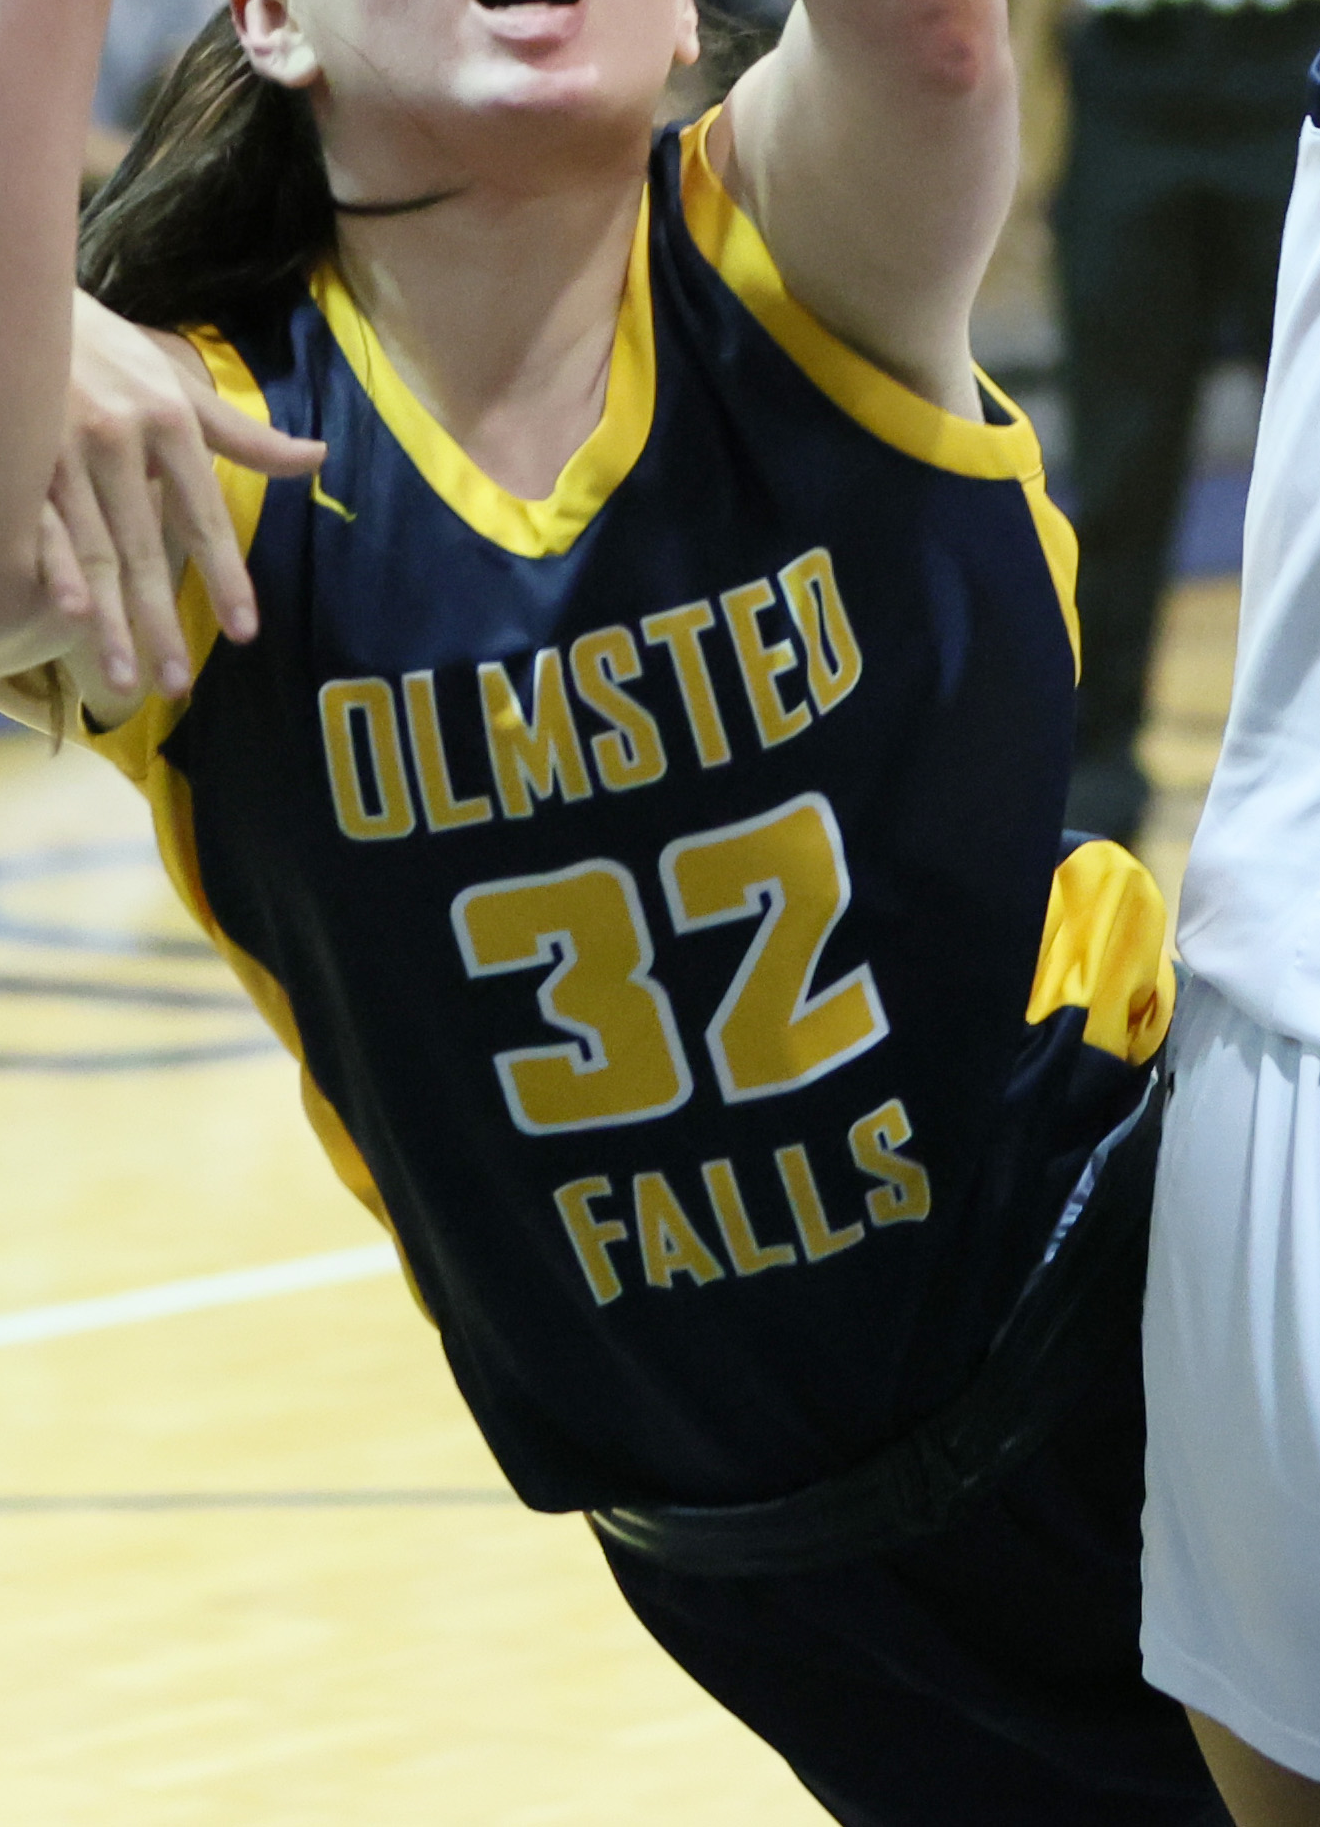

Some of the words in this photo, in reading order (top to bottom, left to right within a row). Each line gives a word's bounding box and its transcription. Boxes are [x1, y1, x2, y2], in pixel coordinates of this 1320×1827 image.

[318, 547, 863, 841] OLMSTED
[450, 791, 890, 1136] 32
[553, 1098, 931, 1307] FALLS
